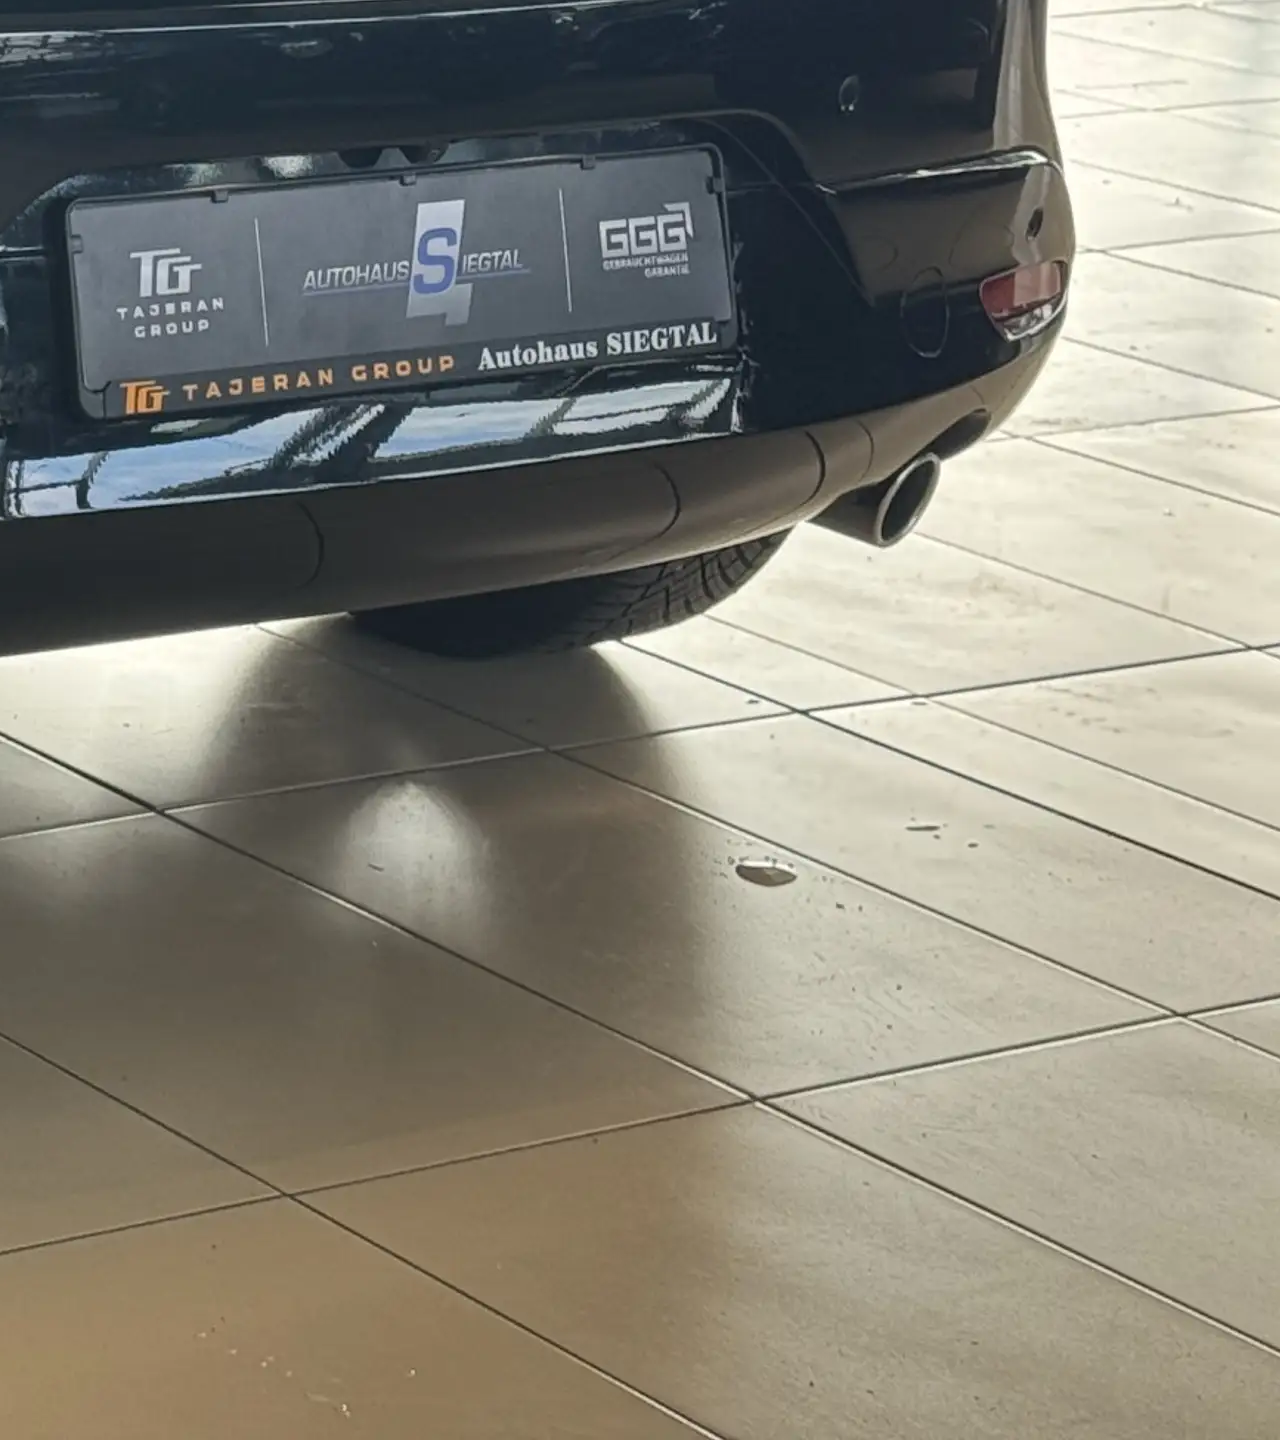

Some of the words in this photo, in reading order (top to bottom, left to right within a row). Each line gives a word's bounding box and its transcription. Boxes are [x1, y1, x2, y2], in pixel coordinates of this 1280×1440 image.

[599, 212, 688, 259] GGG
[129, 247, 202, 298] TG
[302, 259, 410, 291] AUTOHAUS
[116, 297, 224, 320] TAJERAN
[134, 318, 210, 338] GROUP
[477, 340, 599, 371] Autohaus
[606, 321, 717, 356] SIEGTAL
[119, 379, 171, 415] TG
[182, 368, 334, 401] TAJERAN
[351, 355, 455, 382] GROUP
